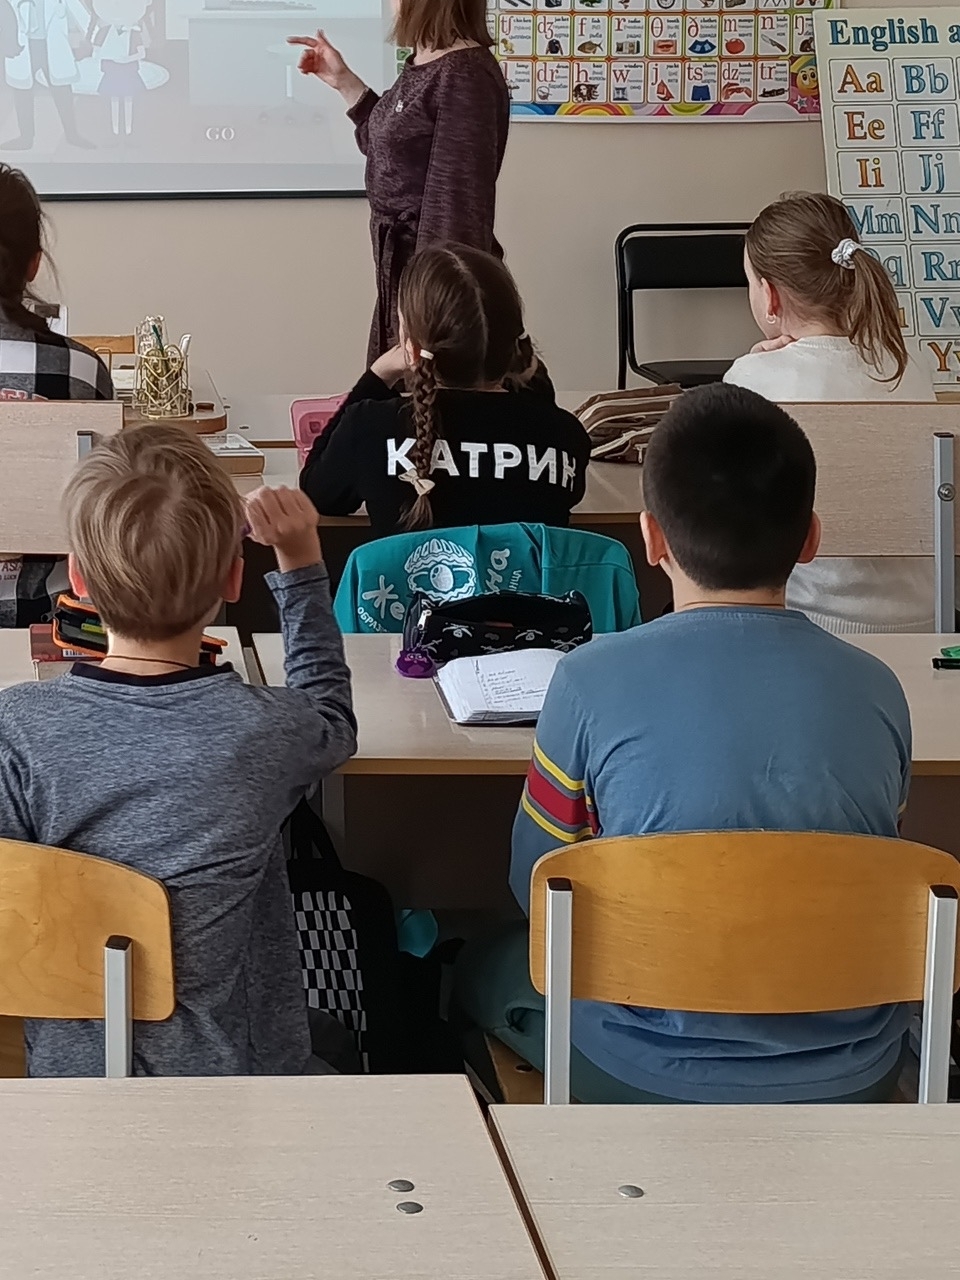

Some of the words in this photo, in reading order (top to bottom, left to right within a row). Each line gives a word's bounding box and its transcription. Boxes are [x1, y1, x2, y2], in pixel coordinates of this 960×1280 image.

[578, 18, 587, 37] f
[615, 18, 626, 32] r
[724, 18, 738, 32] m
[761, 16, 775, 30] n
[828, 18, 939, 52] English
[537, 62, 559, 82] dr
[576, 63, 589, 82] h
[612, 70, 630, 83] w
[687, 63, 703, 80] ts
[722, 63, 739, 80] dz
[760, 62, 776, 80] tr
[838, 64, 884, 94] Aa
[902, 64, 949, 94] Bb
[206, 126, 235, 140] GO
[846, 110, 886, 141] Ee
[912, 109, 946, 140] Ff
[856, 158, 884, 188] Ii
[919, 154, 945, 194] Jj
[847, 204, 902, 235] Mm
[386, 436, 576, 492] КАТРИН
